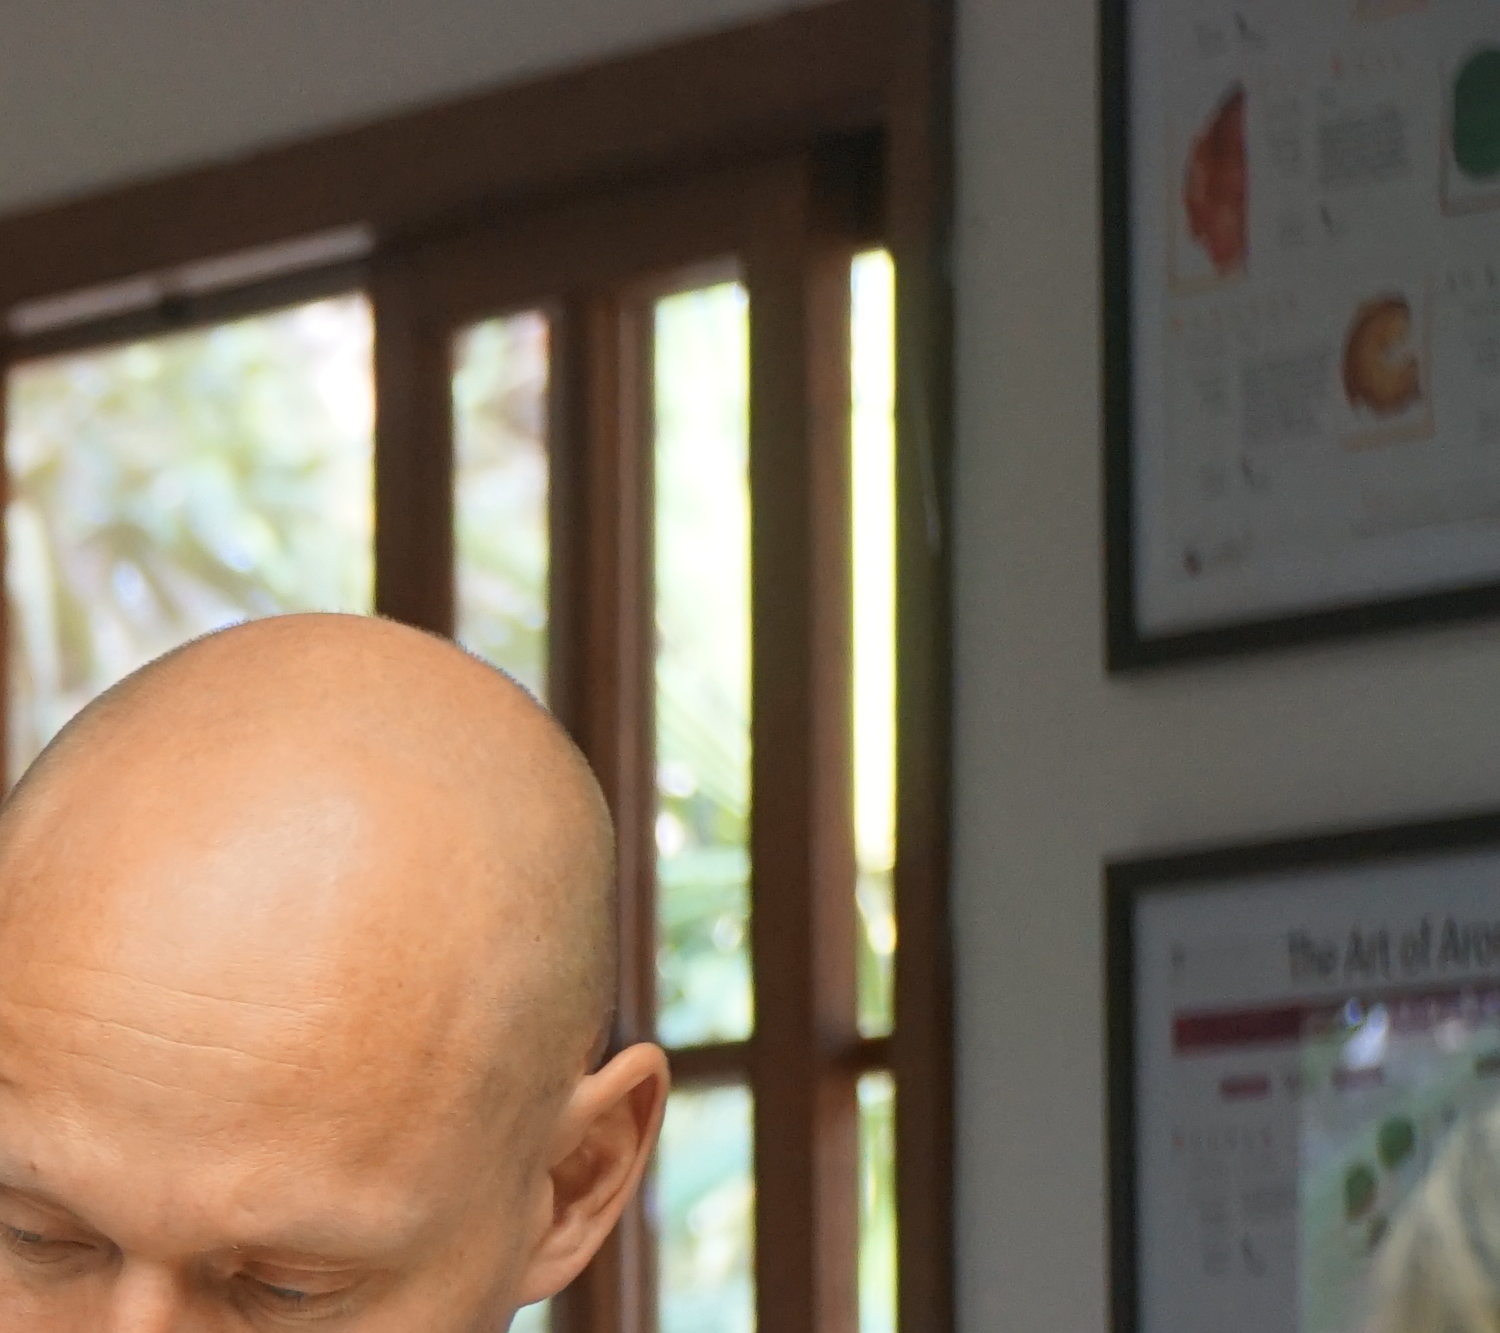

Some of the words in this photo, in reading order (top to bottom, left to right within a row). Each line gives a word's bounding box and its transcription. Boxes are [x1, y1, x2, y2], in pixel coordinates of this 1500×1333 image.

[1287, 925, 1338, 982] The
[1344, 921, 1391, 979] Art
[1400, 912, 1432, 969] of
[1438, 908, 1500, 968] Aro
